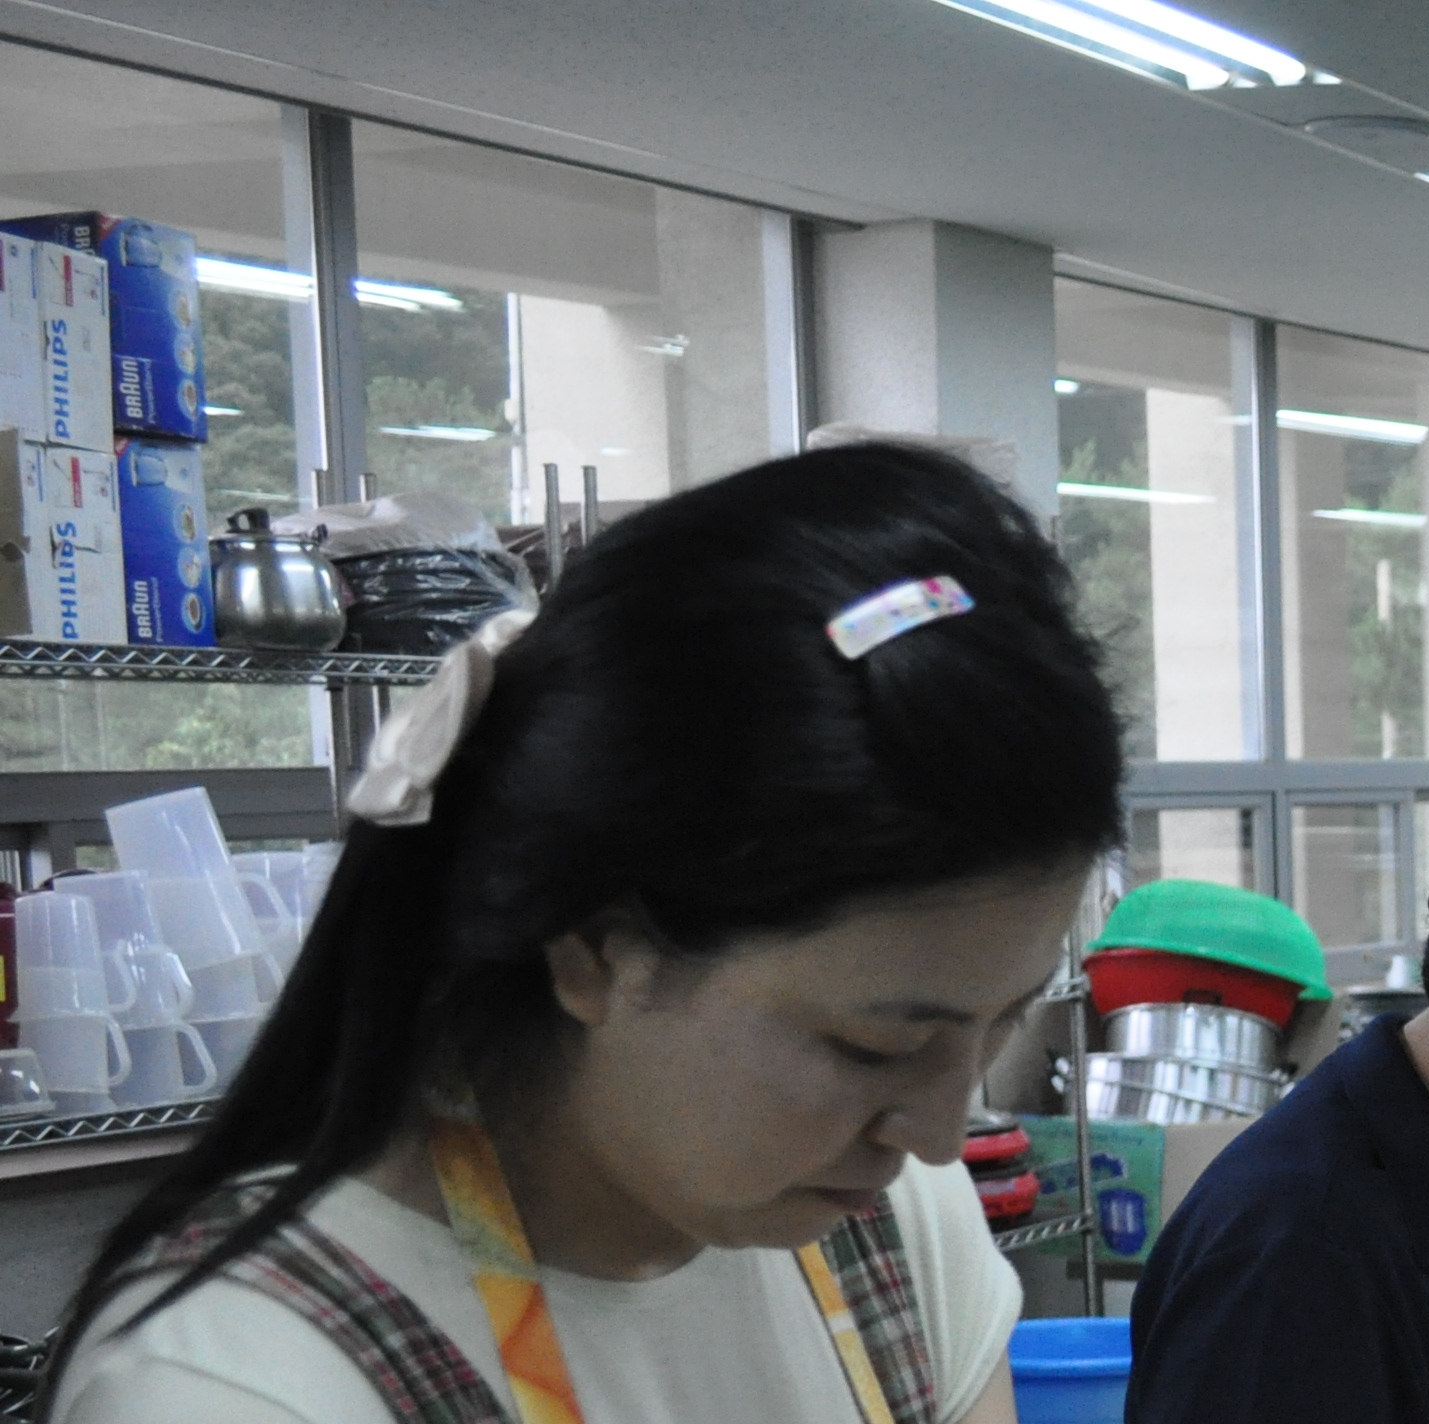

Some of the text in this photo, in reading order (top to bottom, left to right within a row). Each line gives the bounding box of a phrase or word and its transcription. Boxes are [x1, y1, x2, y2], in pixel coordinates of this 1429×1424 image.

[52, 319, 70, 439] PHILIPS
[120, 359, 143, 418] BRAUN
[132, 580, 152, 638] BRAUN
